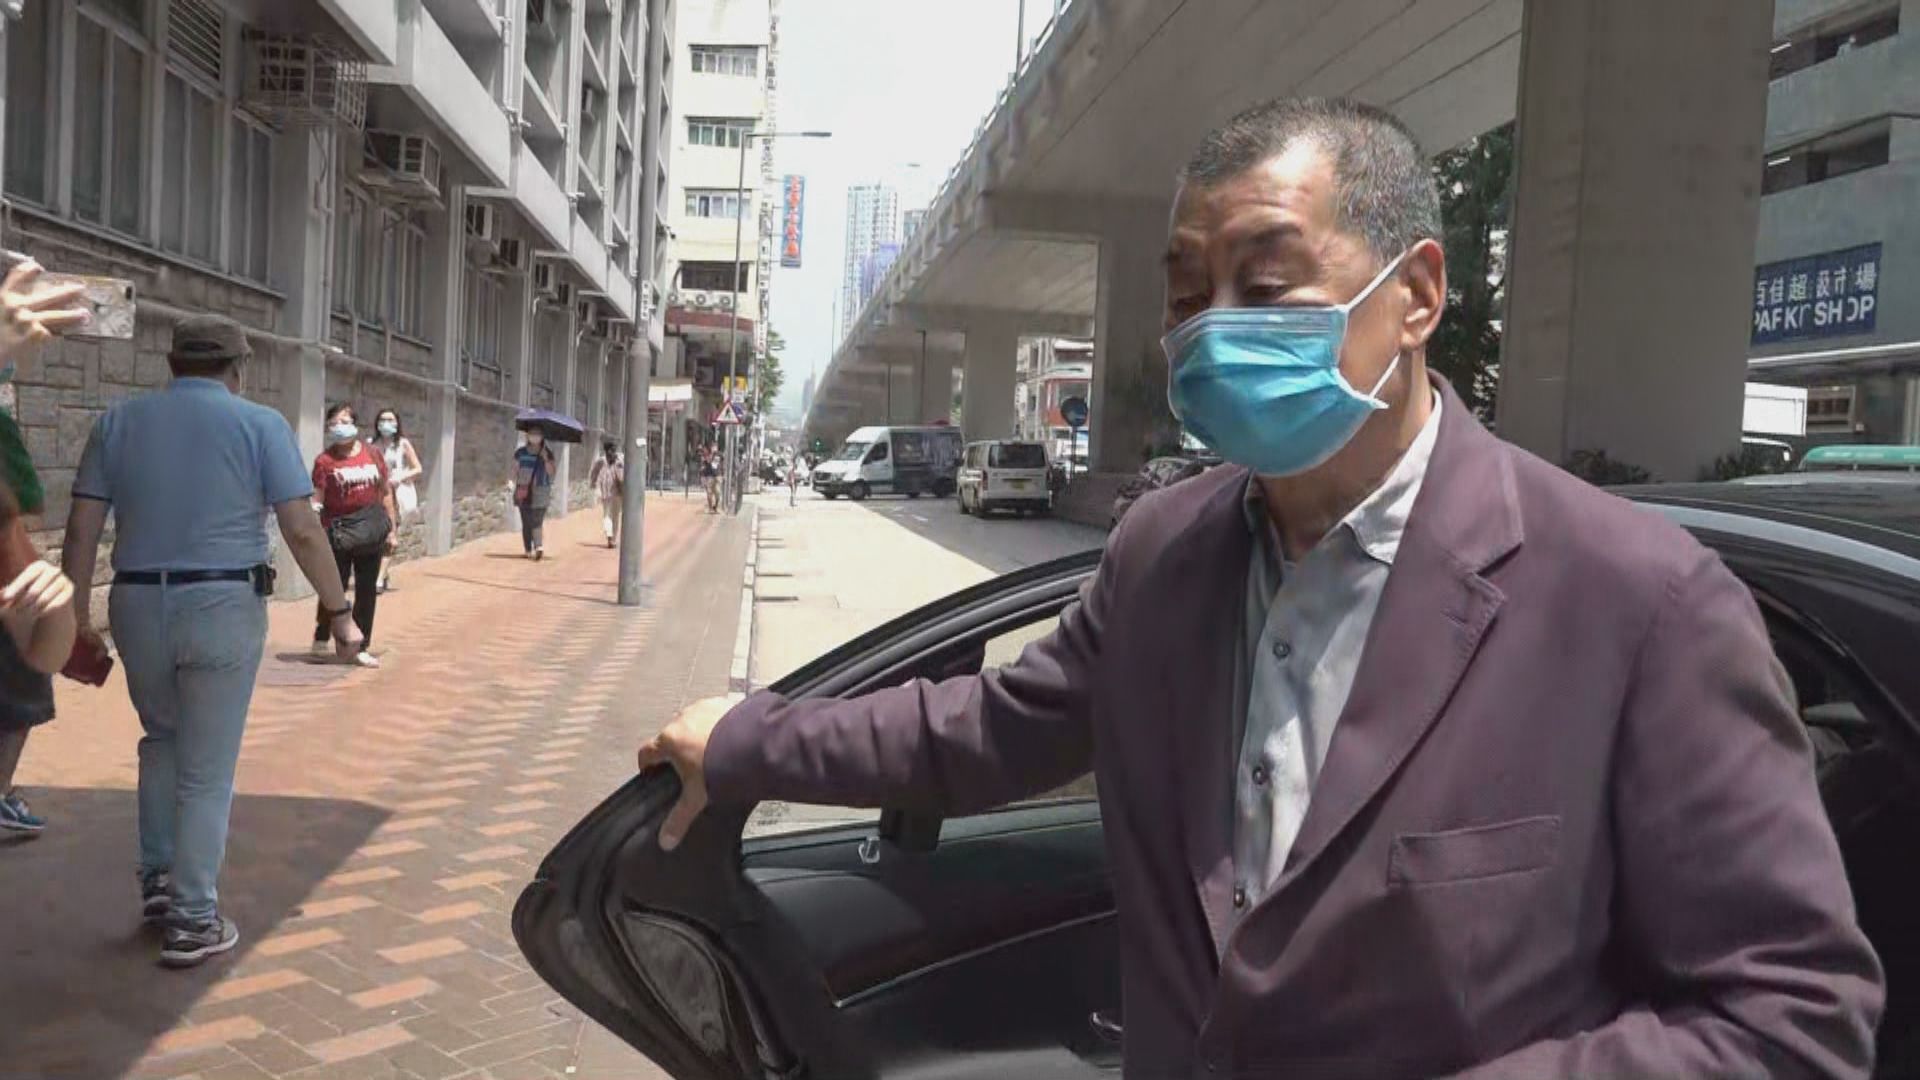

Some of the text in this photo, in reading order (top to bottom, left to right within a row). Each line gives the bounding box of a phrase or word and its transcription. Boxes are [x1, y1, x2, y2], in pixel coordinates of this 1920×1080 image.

[1756, 261, 1877, 306] 百佳超級市場
